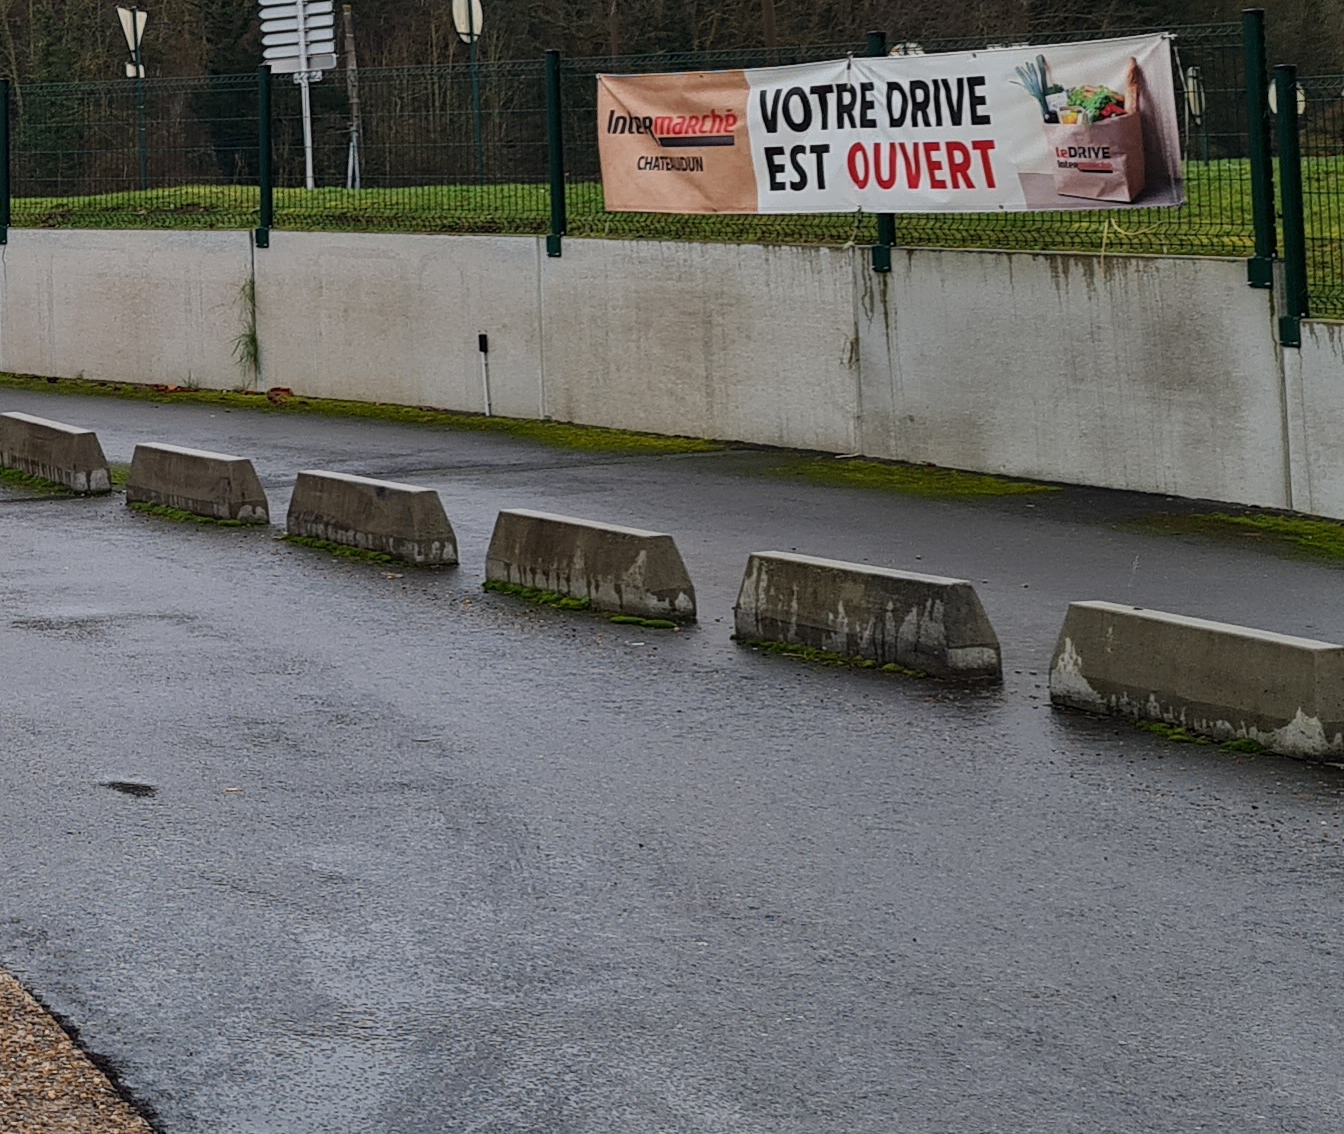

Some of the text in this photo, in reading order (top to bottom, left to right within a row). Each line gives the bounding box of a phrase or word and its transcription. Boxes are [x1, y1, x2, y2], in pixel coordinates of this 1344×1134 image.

[607, 109, 738, 136] Intermarché
[760, 76, 992, 133] VOTRE DRIVE
[764, 140, 997, 191] EST OUVERT
